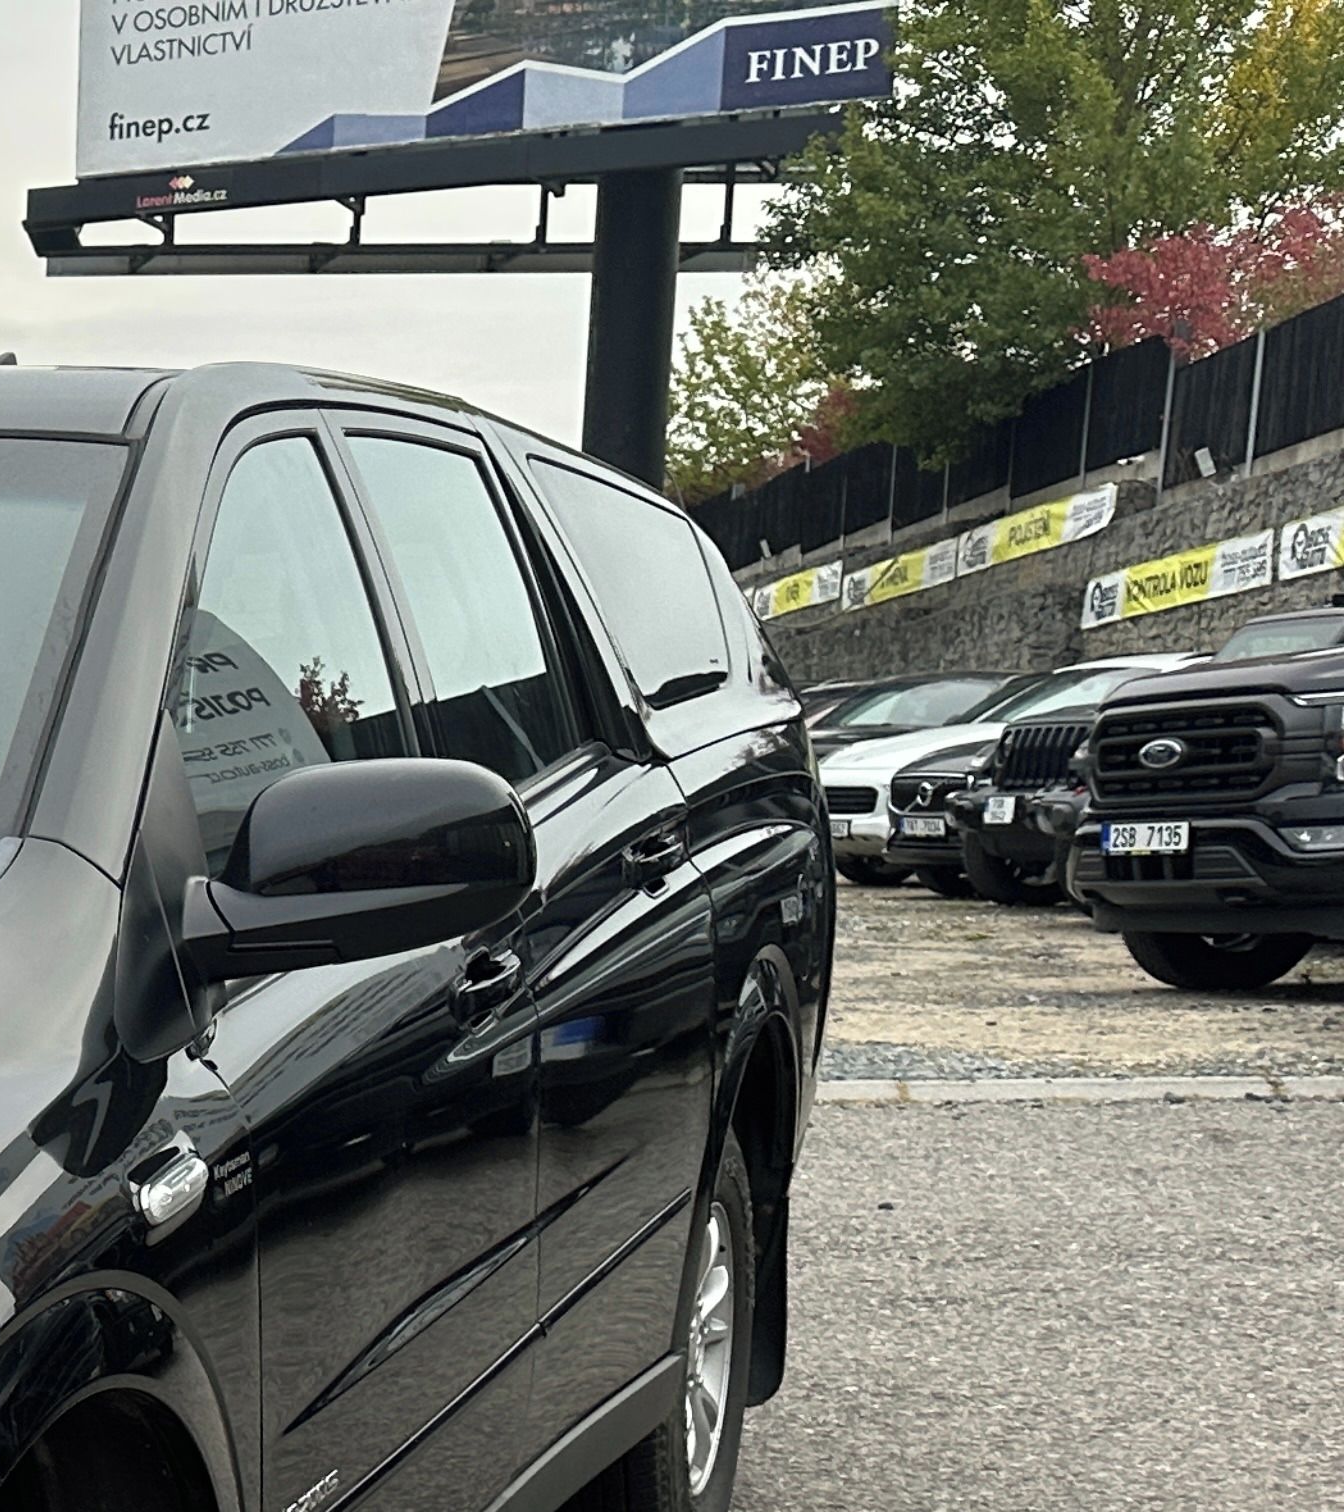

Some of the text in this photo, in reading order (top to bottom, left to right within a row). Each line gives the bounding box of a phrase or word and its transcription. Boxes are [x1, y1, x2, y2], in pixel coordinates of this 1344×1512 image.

[112, 13, 127, 34] V
[110, 23, 253, 65] VLASTNICTVÍ
[744, 38, 880, 83] FINEP
[108, 112, 210, 143] finep.cz
[1113, 825, 1182, 848] 2SB 7135
